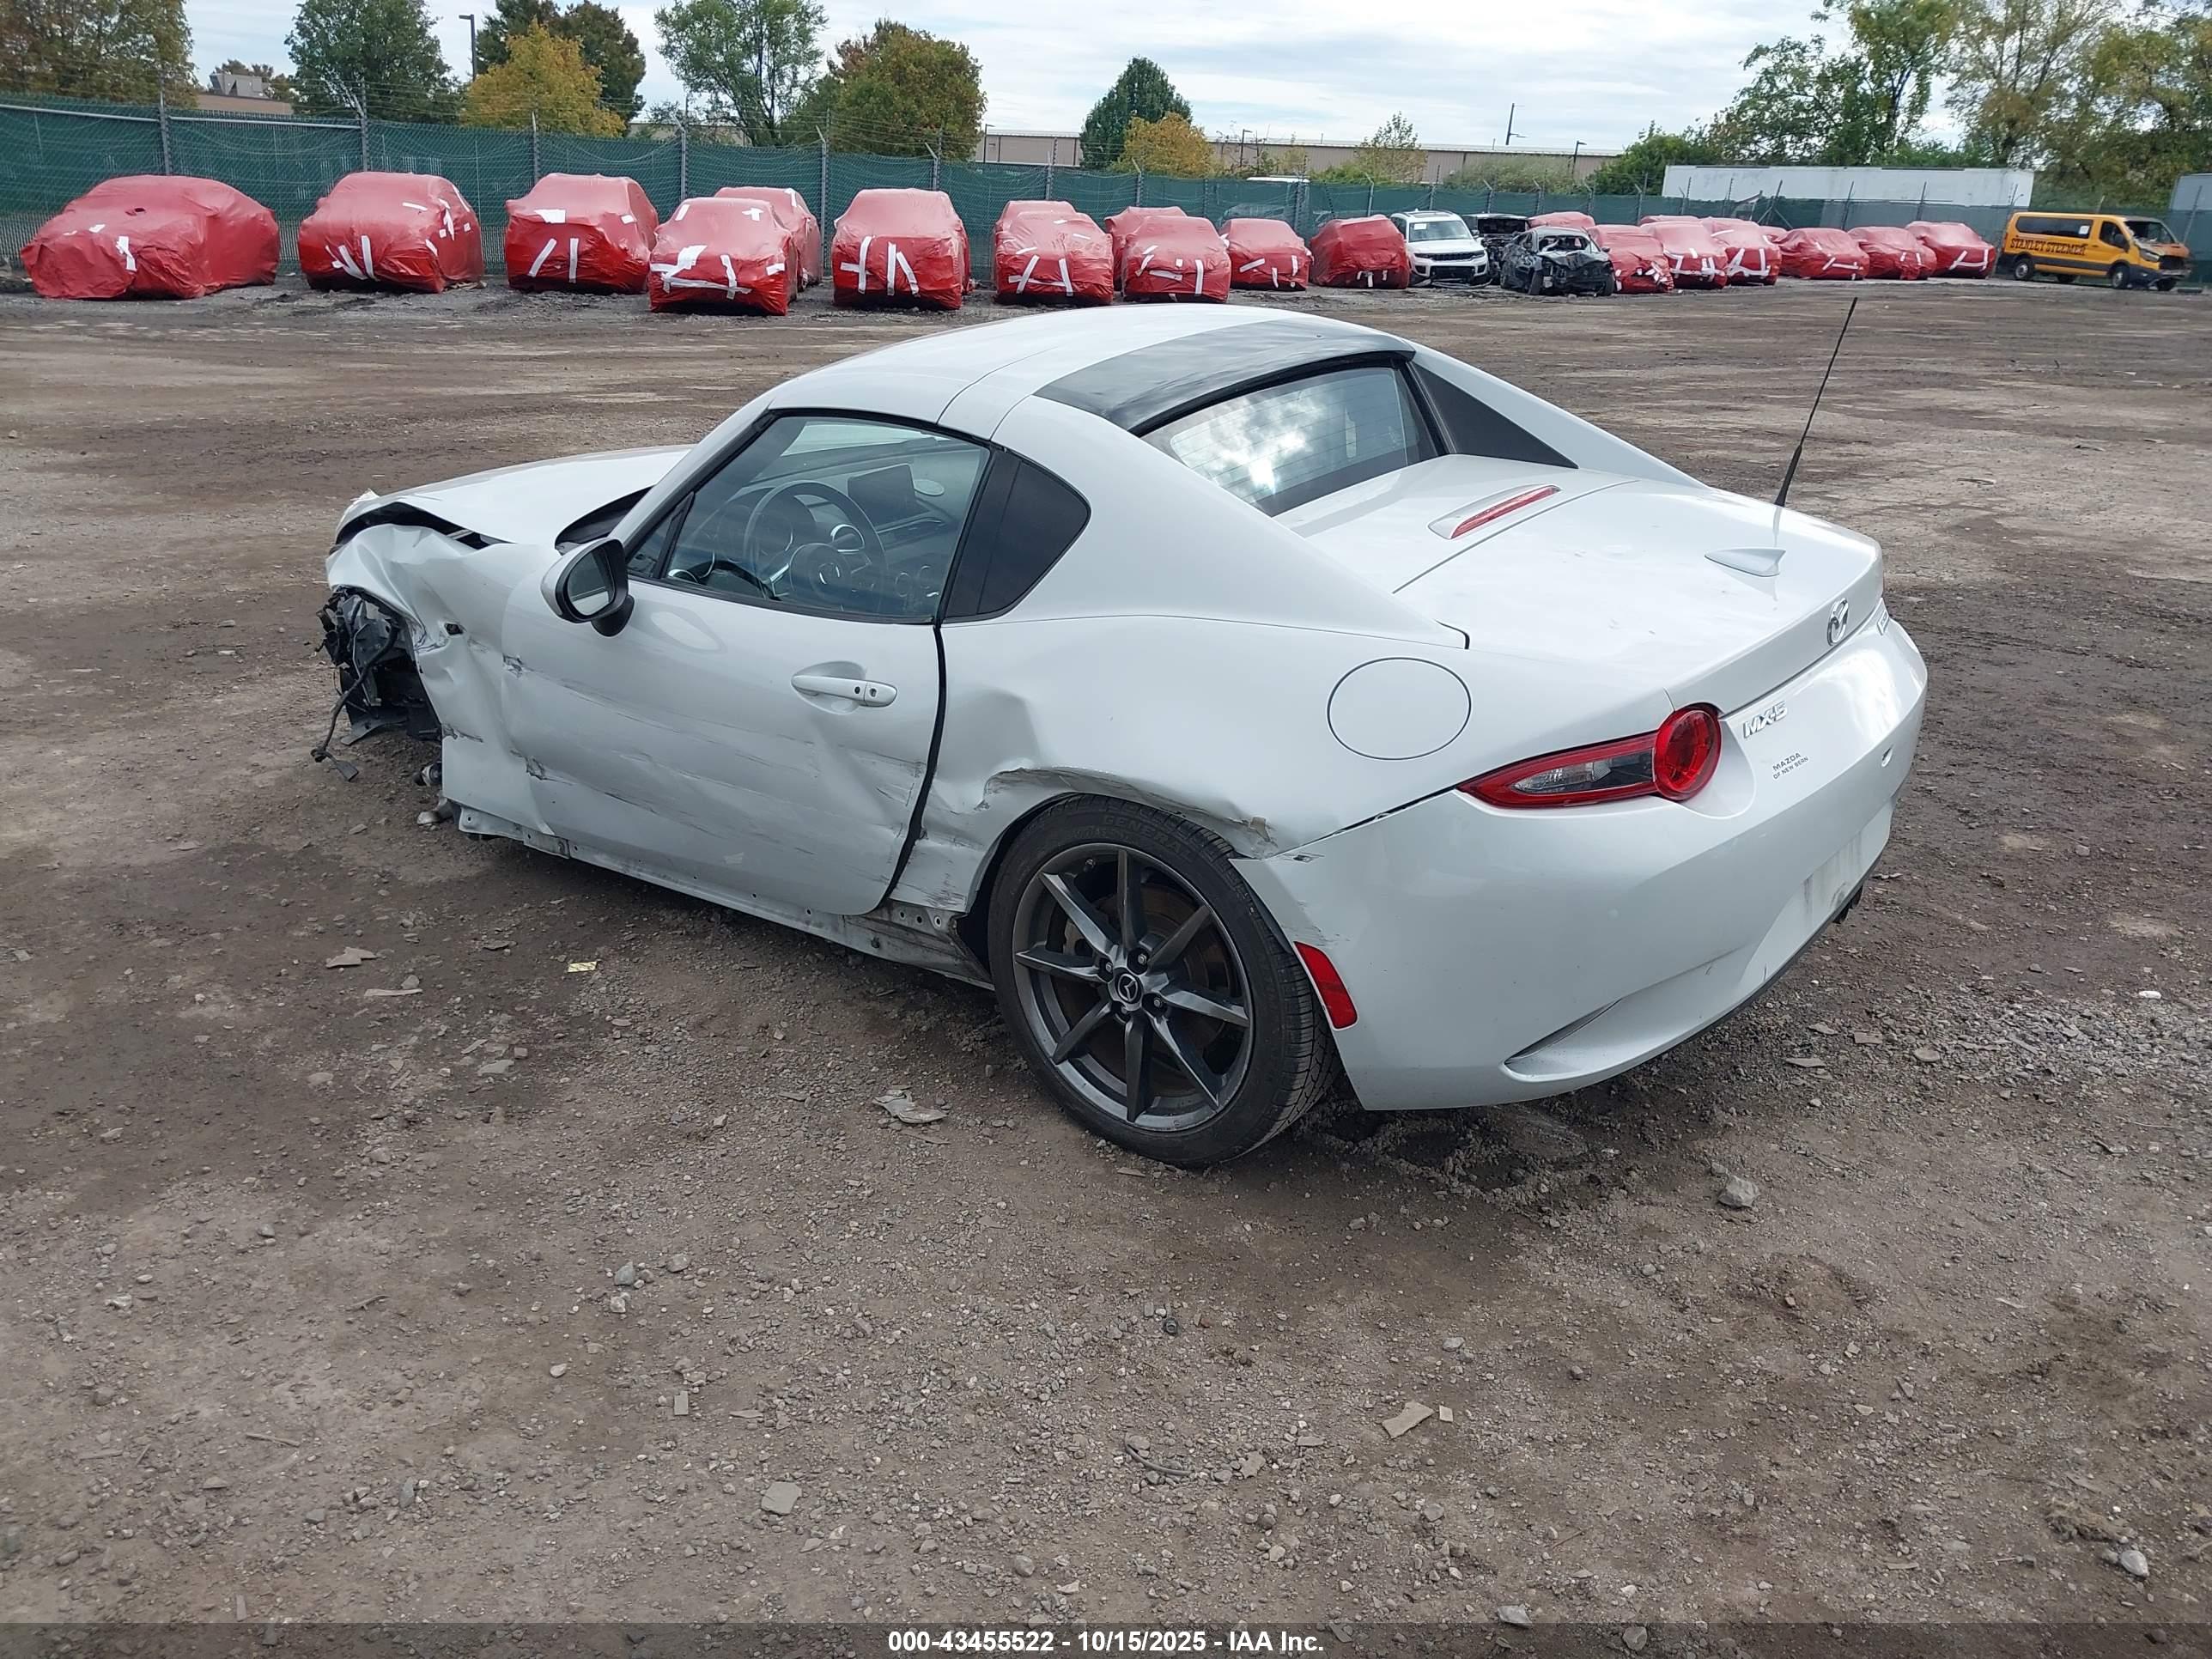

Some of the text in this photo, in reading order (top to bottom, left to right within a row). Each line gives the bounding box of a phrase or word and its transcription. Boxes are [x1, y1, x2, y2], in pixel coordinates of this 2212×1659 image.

[2009, 237, 2088, 257] STANLEY STEEMER
[1742, 700, 1788, 739] MX-5
[1772, 752, 1802, 772] MAZDA
[1772, 756, 1809, 780] OF NEW BERN
[1103, 814, 1193, 863] GENERAL
